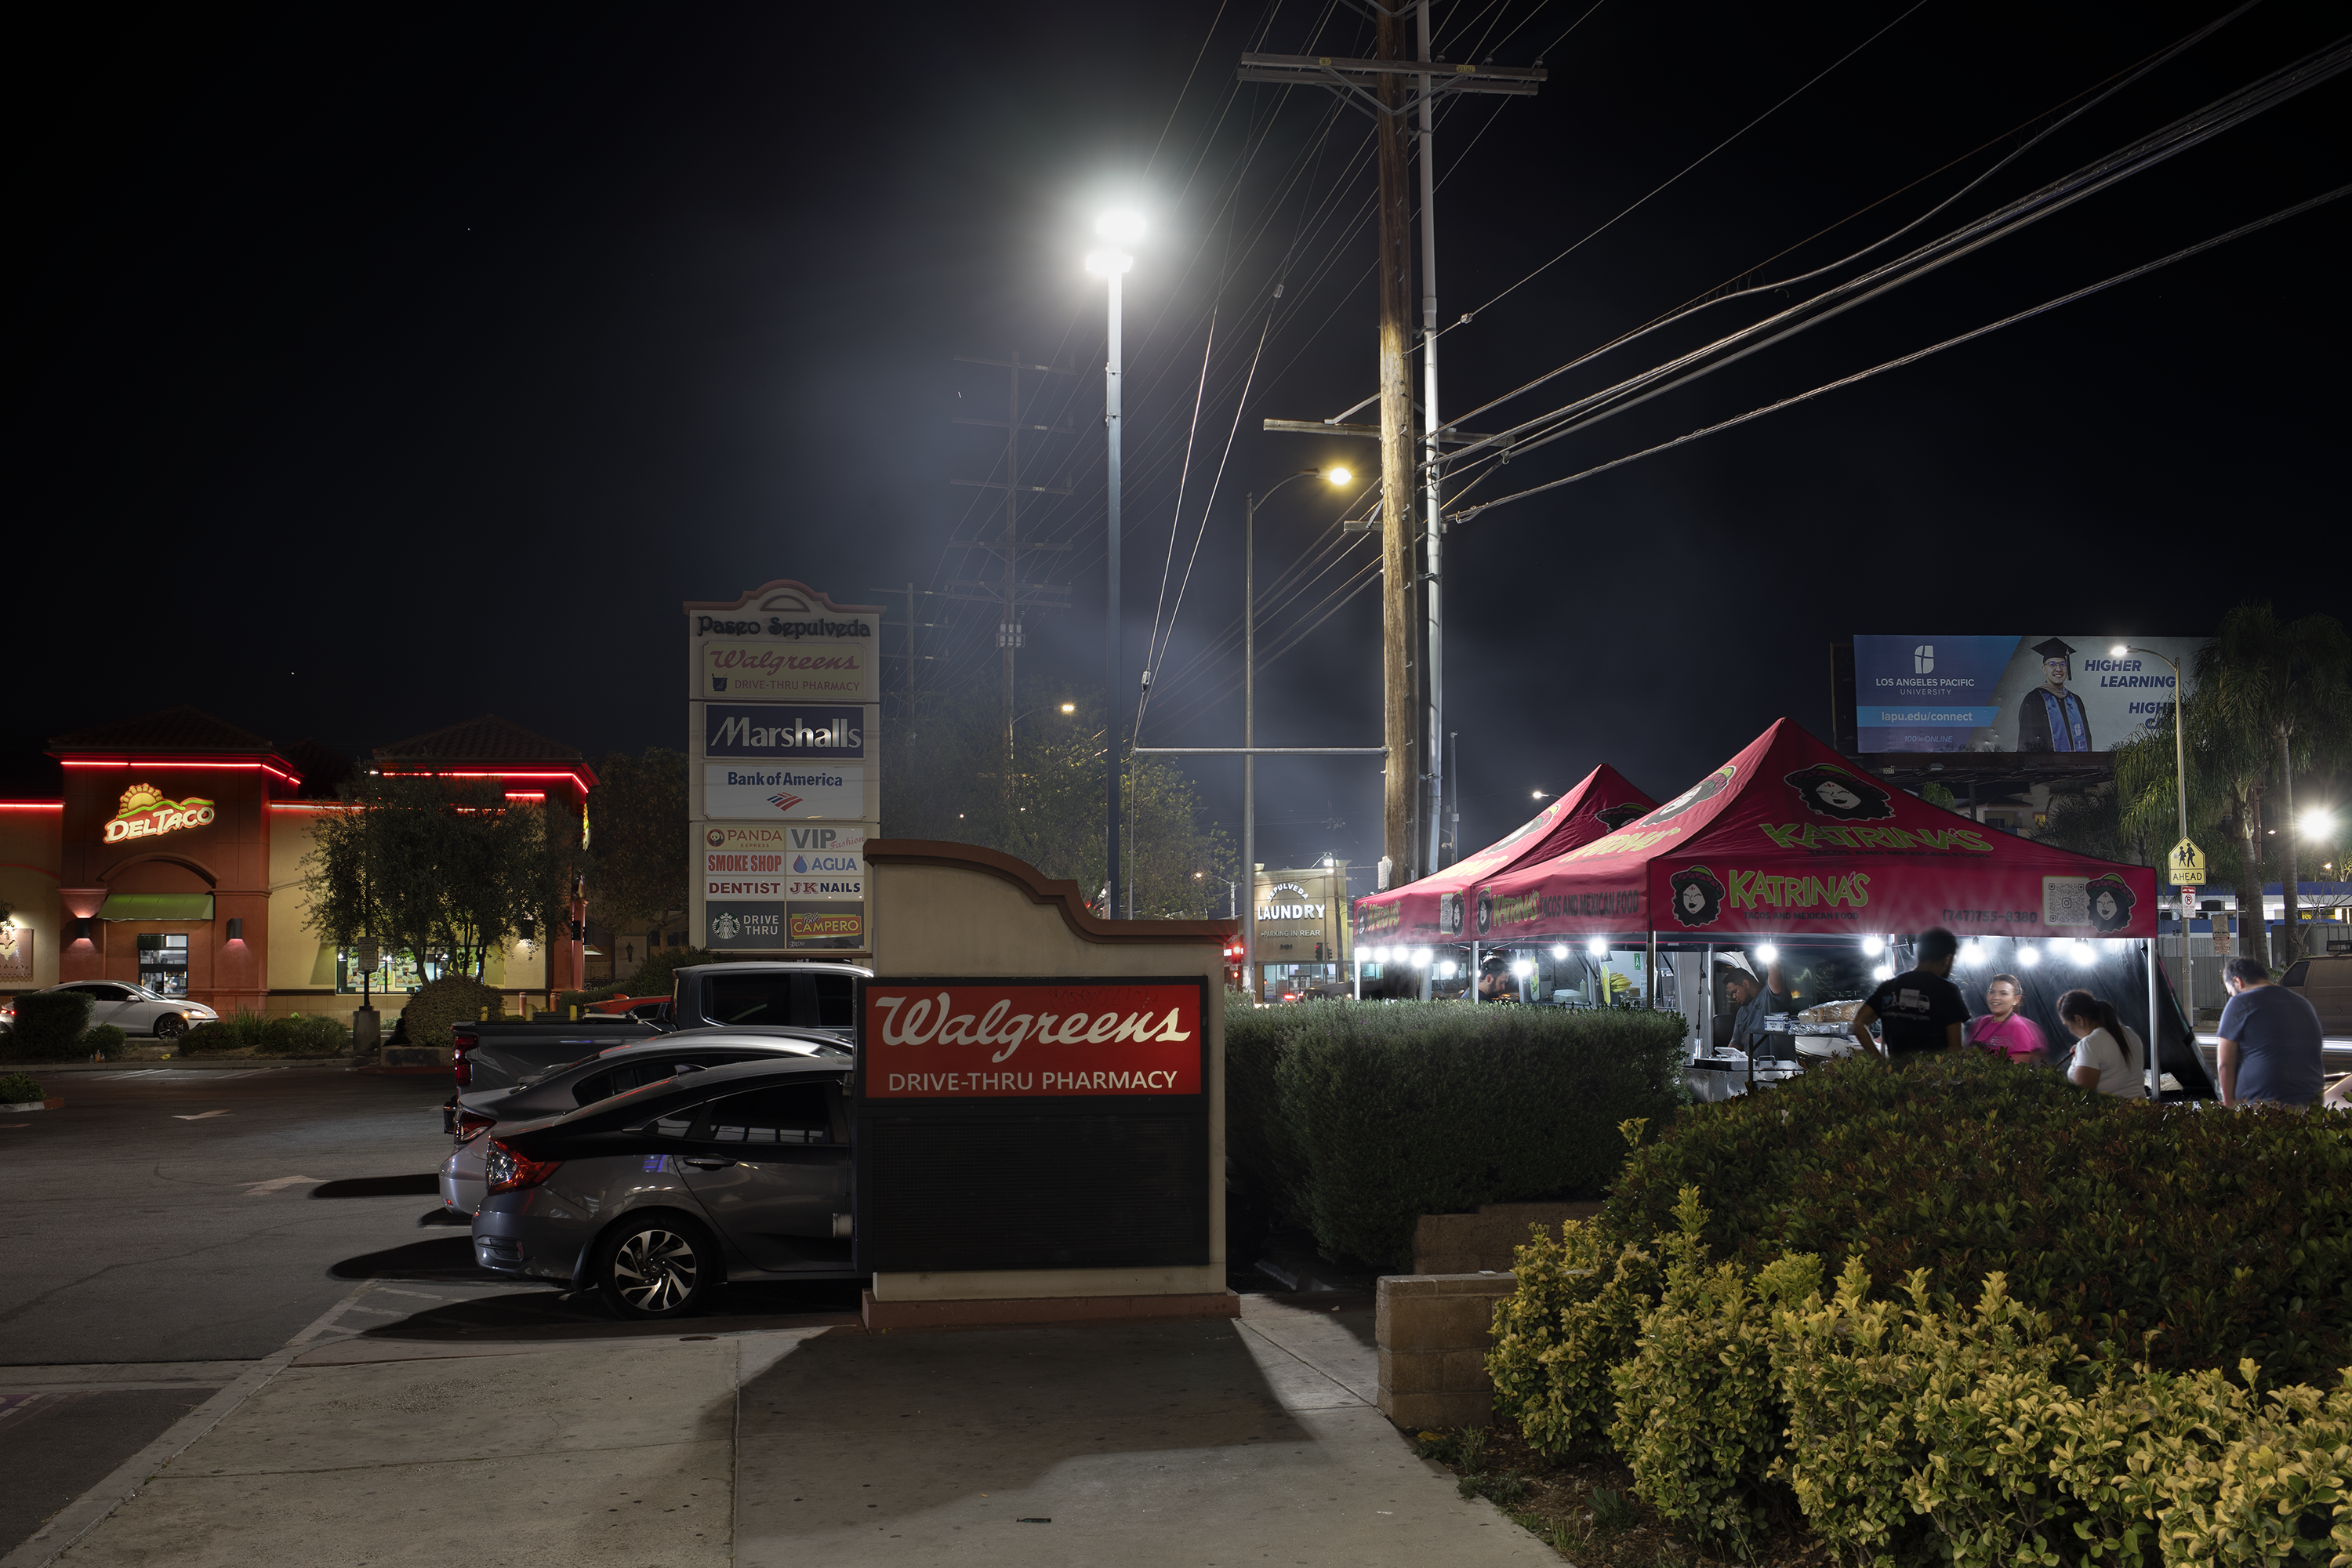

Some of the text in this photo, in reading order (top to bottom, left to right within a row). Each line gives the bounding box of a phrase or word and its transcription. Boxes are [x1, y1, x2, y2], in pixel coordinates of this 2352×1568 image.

[698, 615, 871, 640] Paseo Sepulveda
[709, 649, 861, 676] Walgreens
[2085, 659, 2142, 672] HIGHER
[735, 680, 860, 691] DRIVE-THRU PHARMACY
[1875, 678, 1975, 687] LOS ANGELES PACIFIC
[2100, 676, 2176, 688] LEARNING
[1882, 711, 1973, 723] lapu.edu/connect
[710, 717, 862, 749] Marshalls
[728, 771, 843, 786] Bank of America
[727, 829, 783, 841] PANDA
[790, 829, 837, 849] VIP
[829, 836, 864, 851] Fashion
[708, 855, 782, 872] SMOKE SHOP
[811, 857, 858, 871] AGUA
[709, 882, 781, 894] DENTIST
[789, 882, 861, 895] JK NAILS
[1267, 883, 1309, 902] SEPULVEDA
[1539, 895, 1561, 918] TACOS
[1563, 893, 1578, 916] AND
[1580, 891, 1614, 916] MEXICAN
[1616, 890, 1639, 915] FOOD
[800, 912, 821, 924] Pollo
[1258, 904, 1326, 920] LAUNDRY
[743, 915, 779, 924] DRIVE
[793, 920, 859, 933] CAMPERO
[745, 925, 779, 935] THRU
[875, 992, 1192, 1063] Walgreens
[888, 1070, 1178, 1092] DRIVE-THRU PHARMACY
